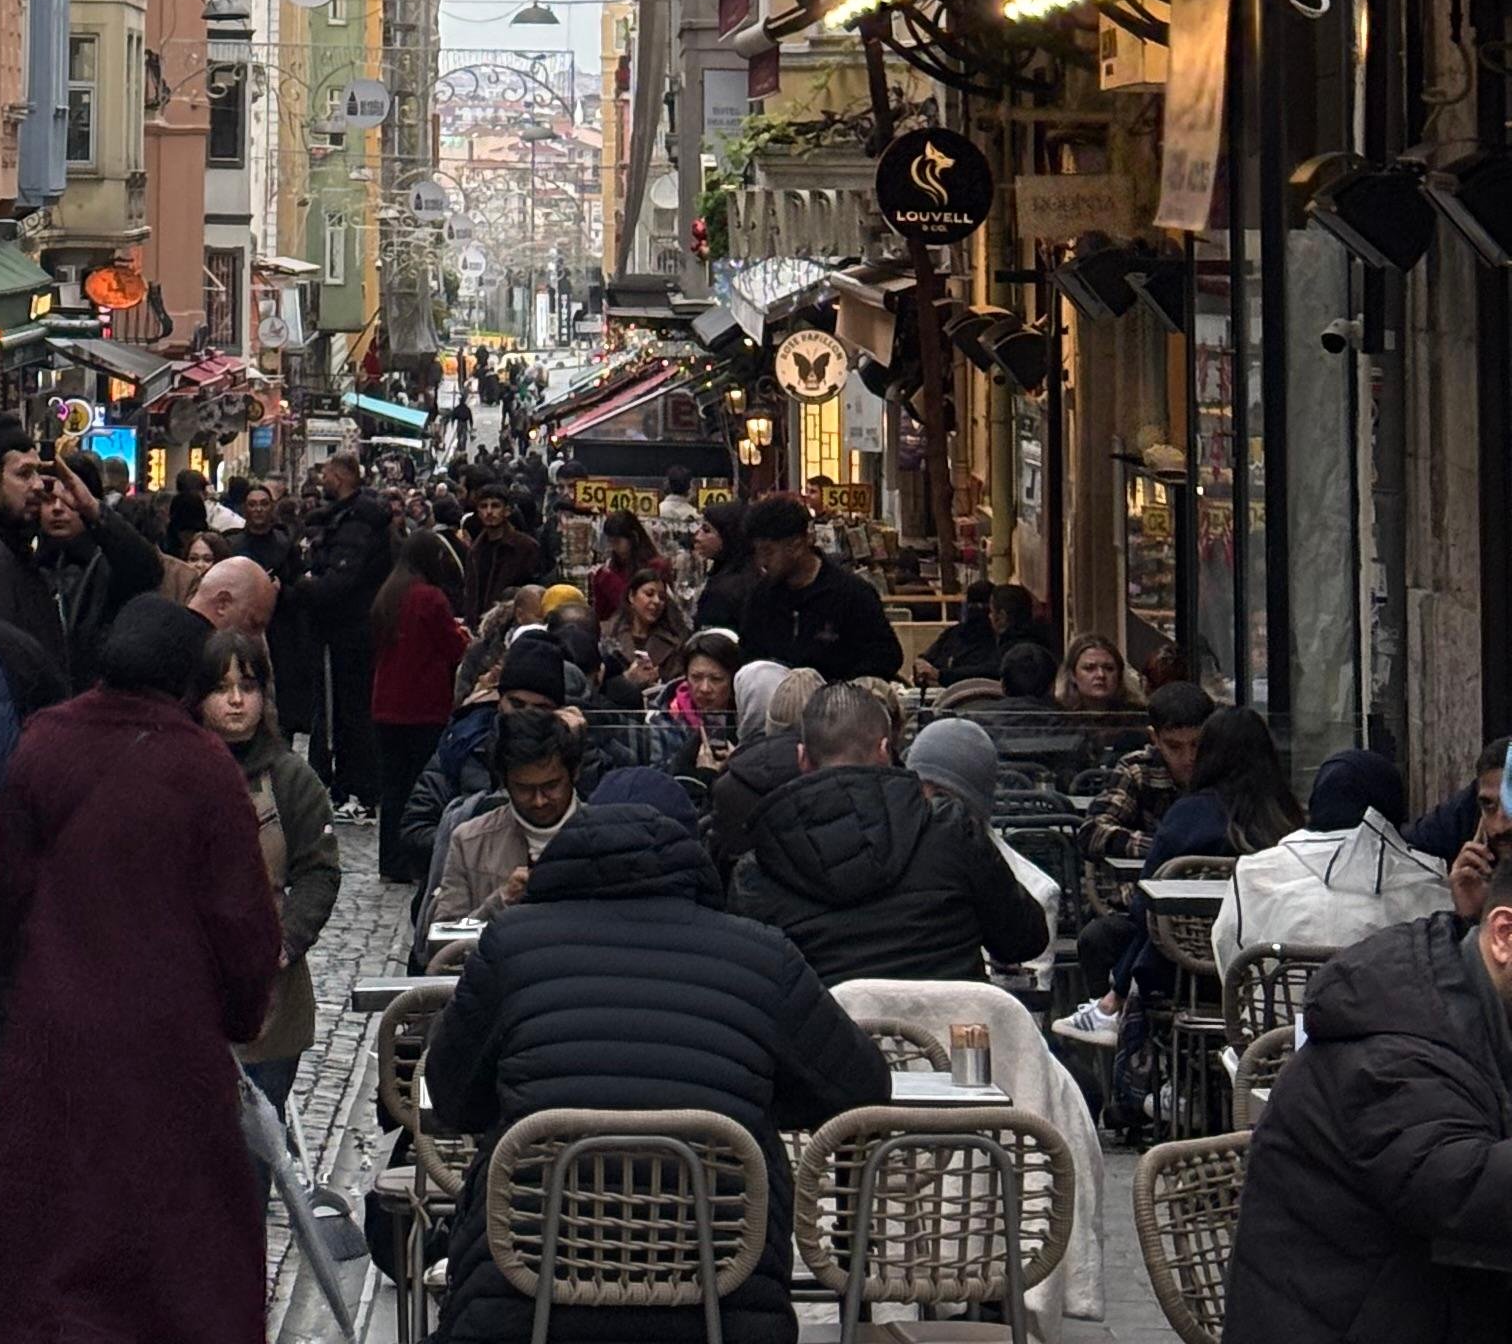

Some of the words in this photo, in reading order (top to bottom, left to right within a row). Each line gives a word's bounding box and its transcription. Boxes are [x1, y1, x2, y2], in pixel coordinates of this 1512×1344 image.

[896, 210, 974, 224] LOUVELL
[582, 486, 605, 504] 50
[610, 493, 631, 511] 40
[829, 490, 849, 507] 50
